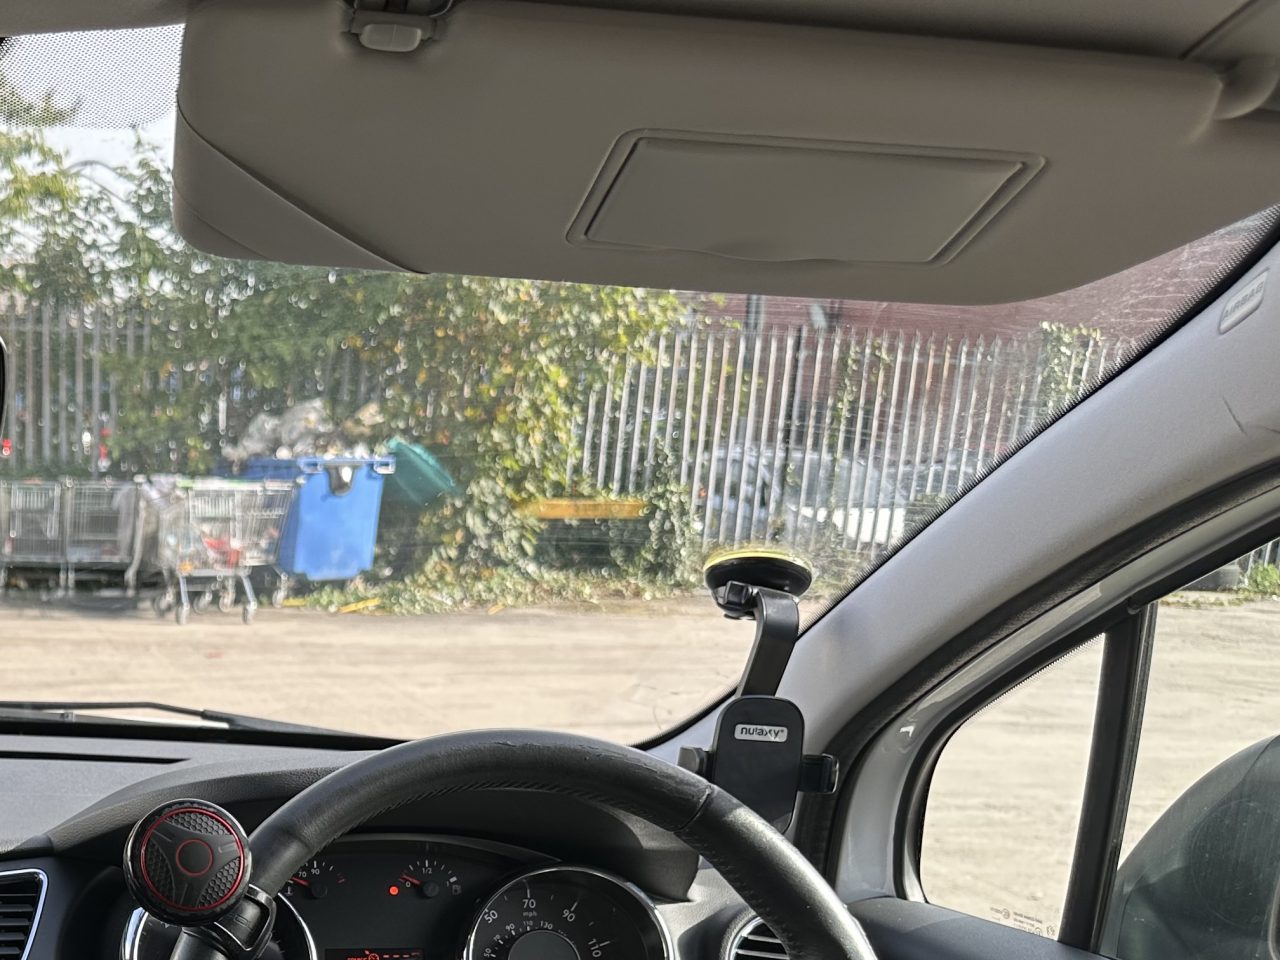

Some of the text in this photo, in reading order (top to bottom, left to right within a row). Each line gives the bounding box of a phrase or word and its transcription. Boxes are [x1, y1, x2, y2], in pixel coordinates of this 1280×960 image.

[298, 867, 320, 878] 70 90
[422, 867, 433, 875] 1/2
[522, 910, 538, 918] mph
[484, 898, 602, 958] 50 70 90 110
